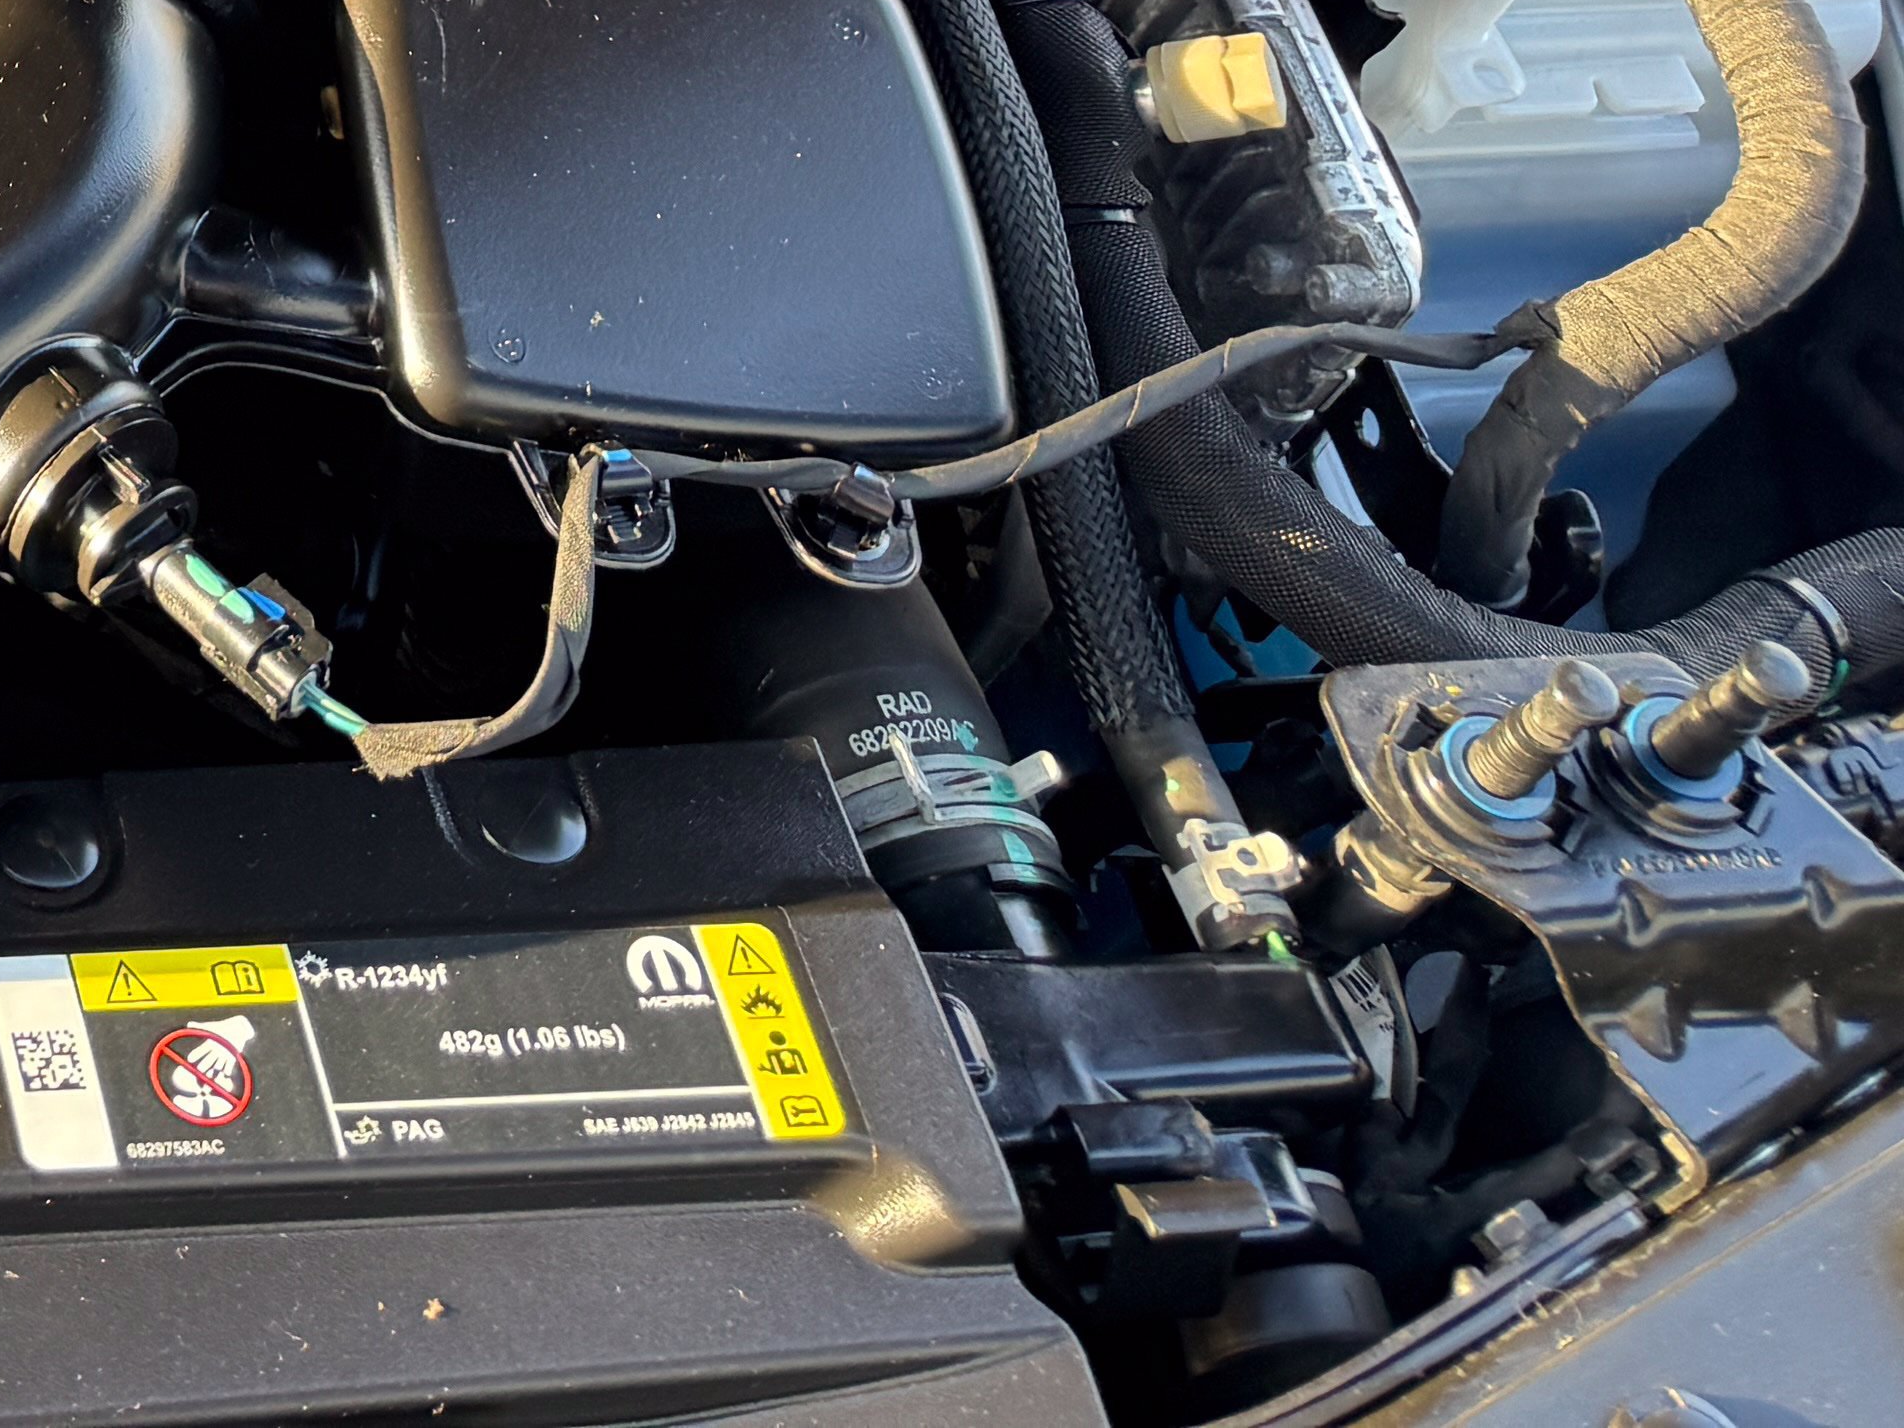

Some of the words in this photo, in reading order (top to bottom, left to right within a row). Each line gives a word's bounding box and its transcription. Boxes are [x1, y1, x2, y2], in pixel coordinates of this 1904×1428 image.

[876, 691, 933, 719] RAD
[335, 963, 447, 991] R-1234yf
[440, 1030, 504, 1056] 482g
[507, 1021, 571, 1056] (1.06
[573, 1023, 625, 1052] lbs)
[391, 1118, 445, 1142] PAG
[583, 1117, 620, 1134] SAE
